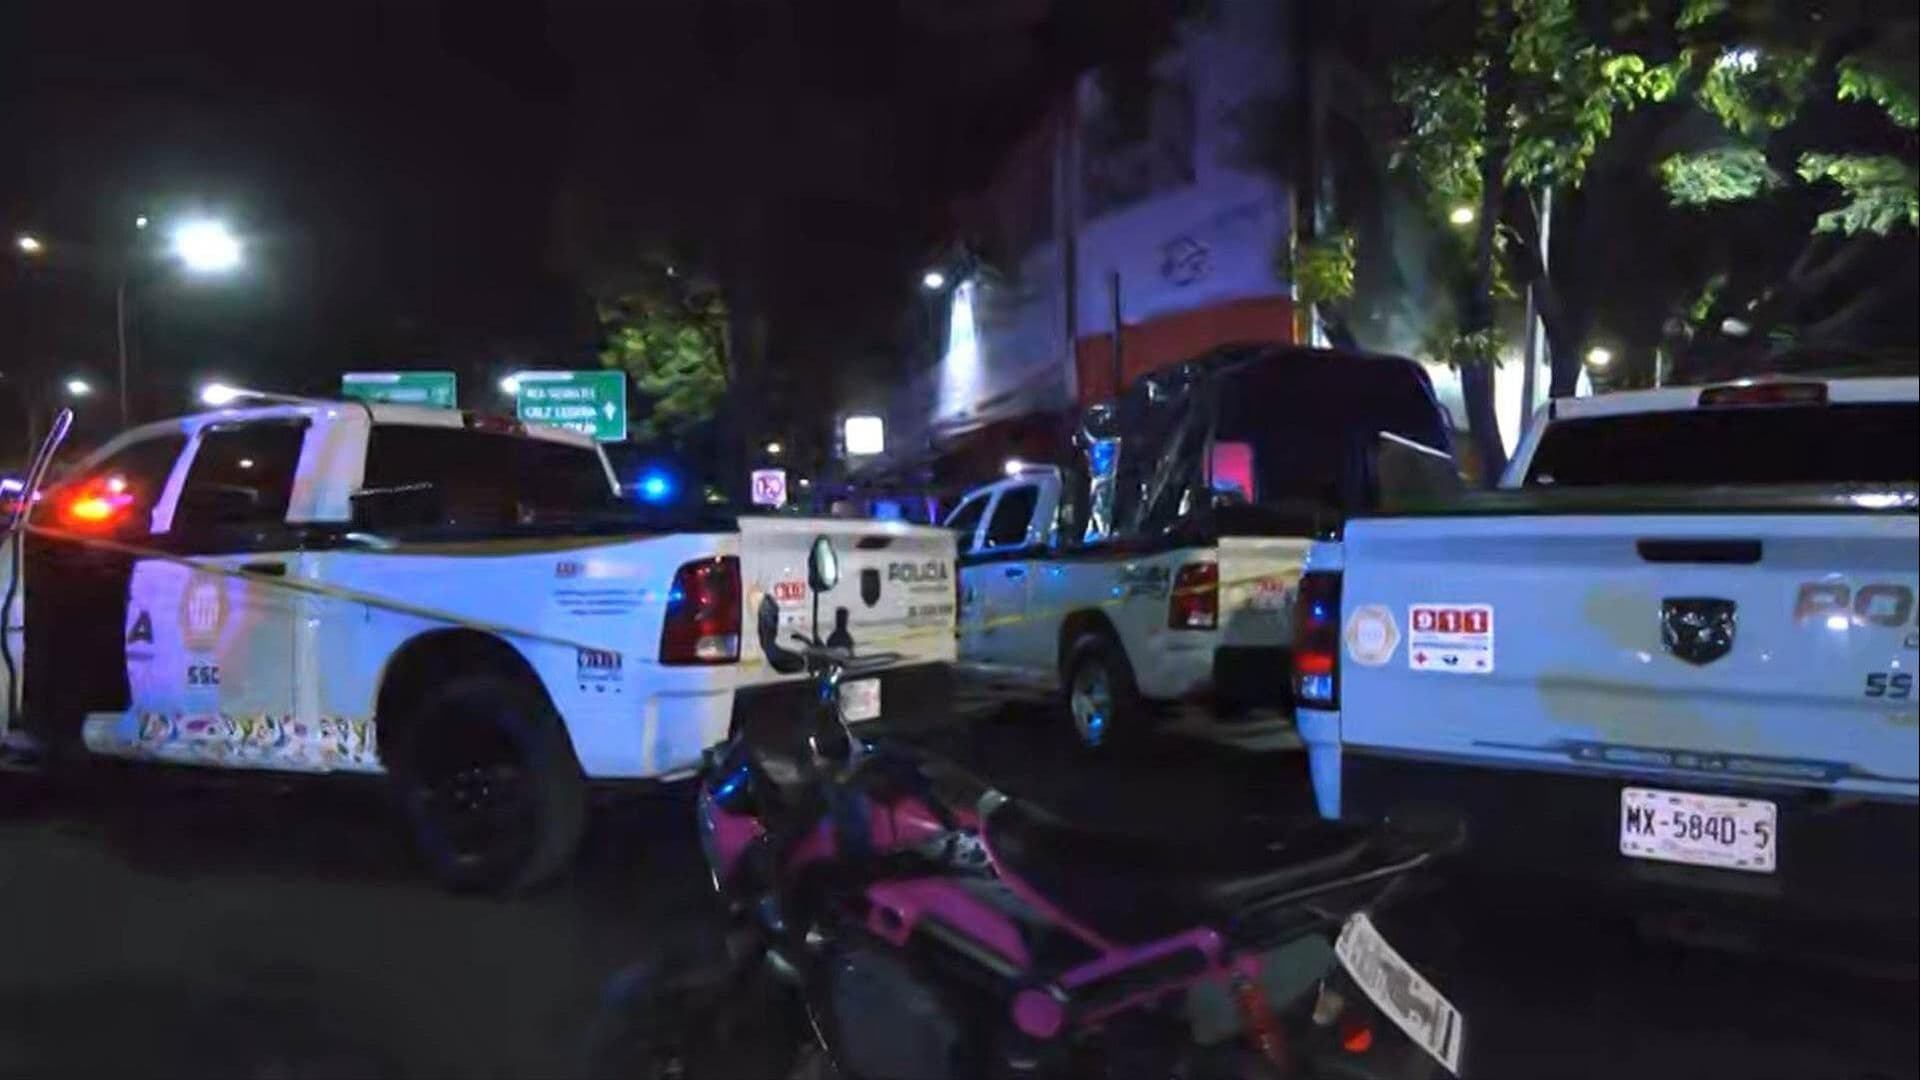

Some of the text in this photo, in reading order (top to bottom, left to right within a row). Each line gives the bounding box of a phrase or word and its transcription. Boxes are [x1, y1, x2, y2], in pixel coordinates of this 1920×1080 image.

[1416, 610, 1483, 632] 911
[1793, 582, 1918, 631] PO
[1626, 806, 1769, 851] MX-584D-5
